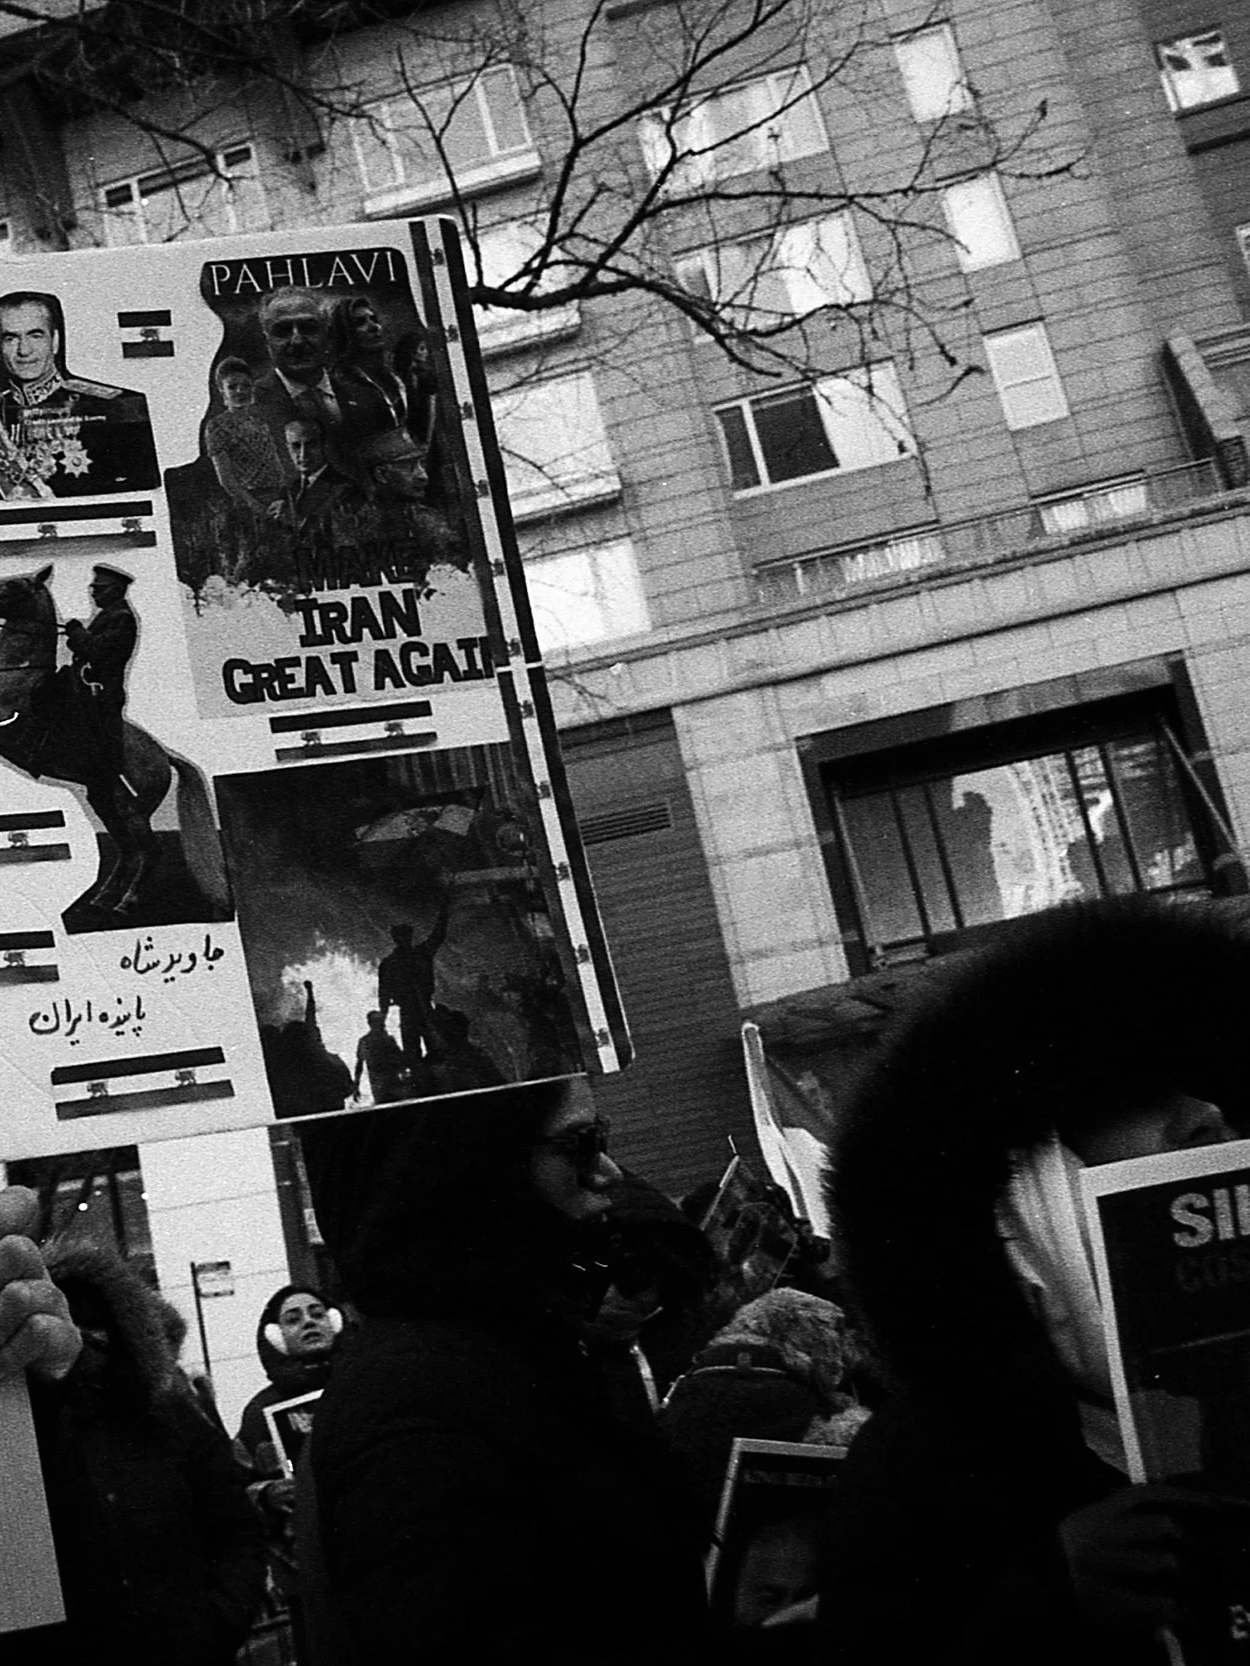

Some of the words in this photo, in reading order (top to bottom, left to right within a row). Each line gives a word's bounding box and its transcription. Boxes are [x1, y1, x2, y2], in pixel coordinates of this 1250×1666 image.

[209, 250, 397, 296] PAHLAVI
[295, 588, 422, 648] IRAN
[222, 651, 359, 705] GREAT
[29, 998, 93, 1046] ایران
